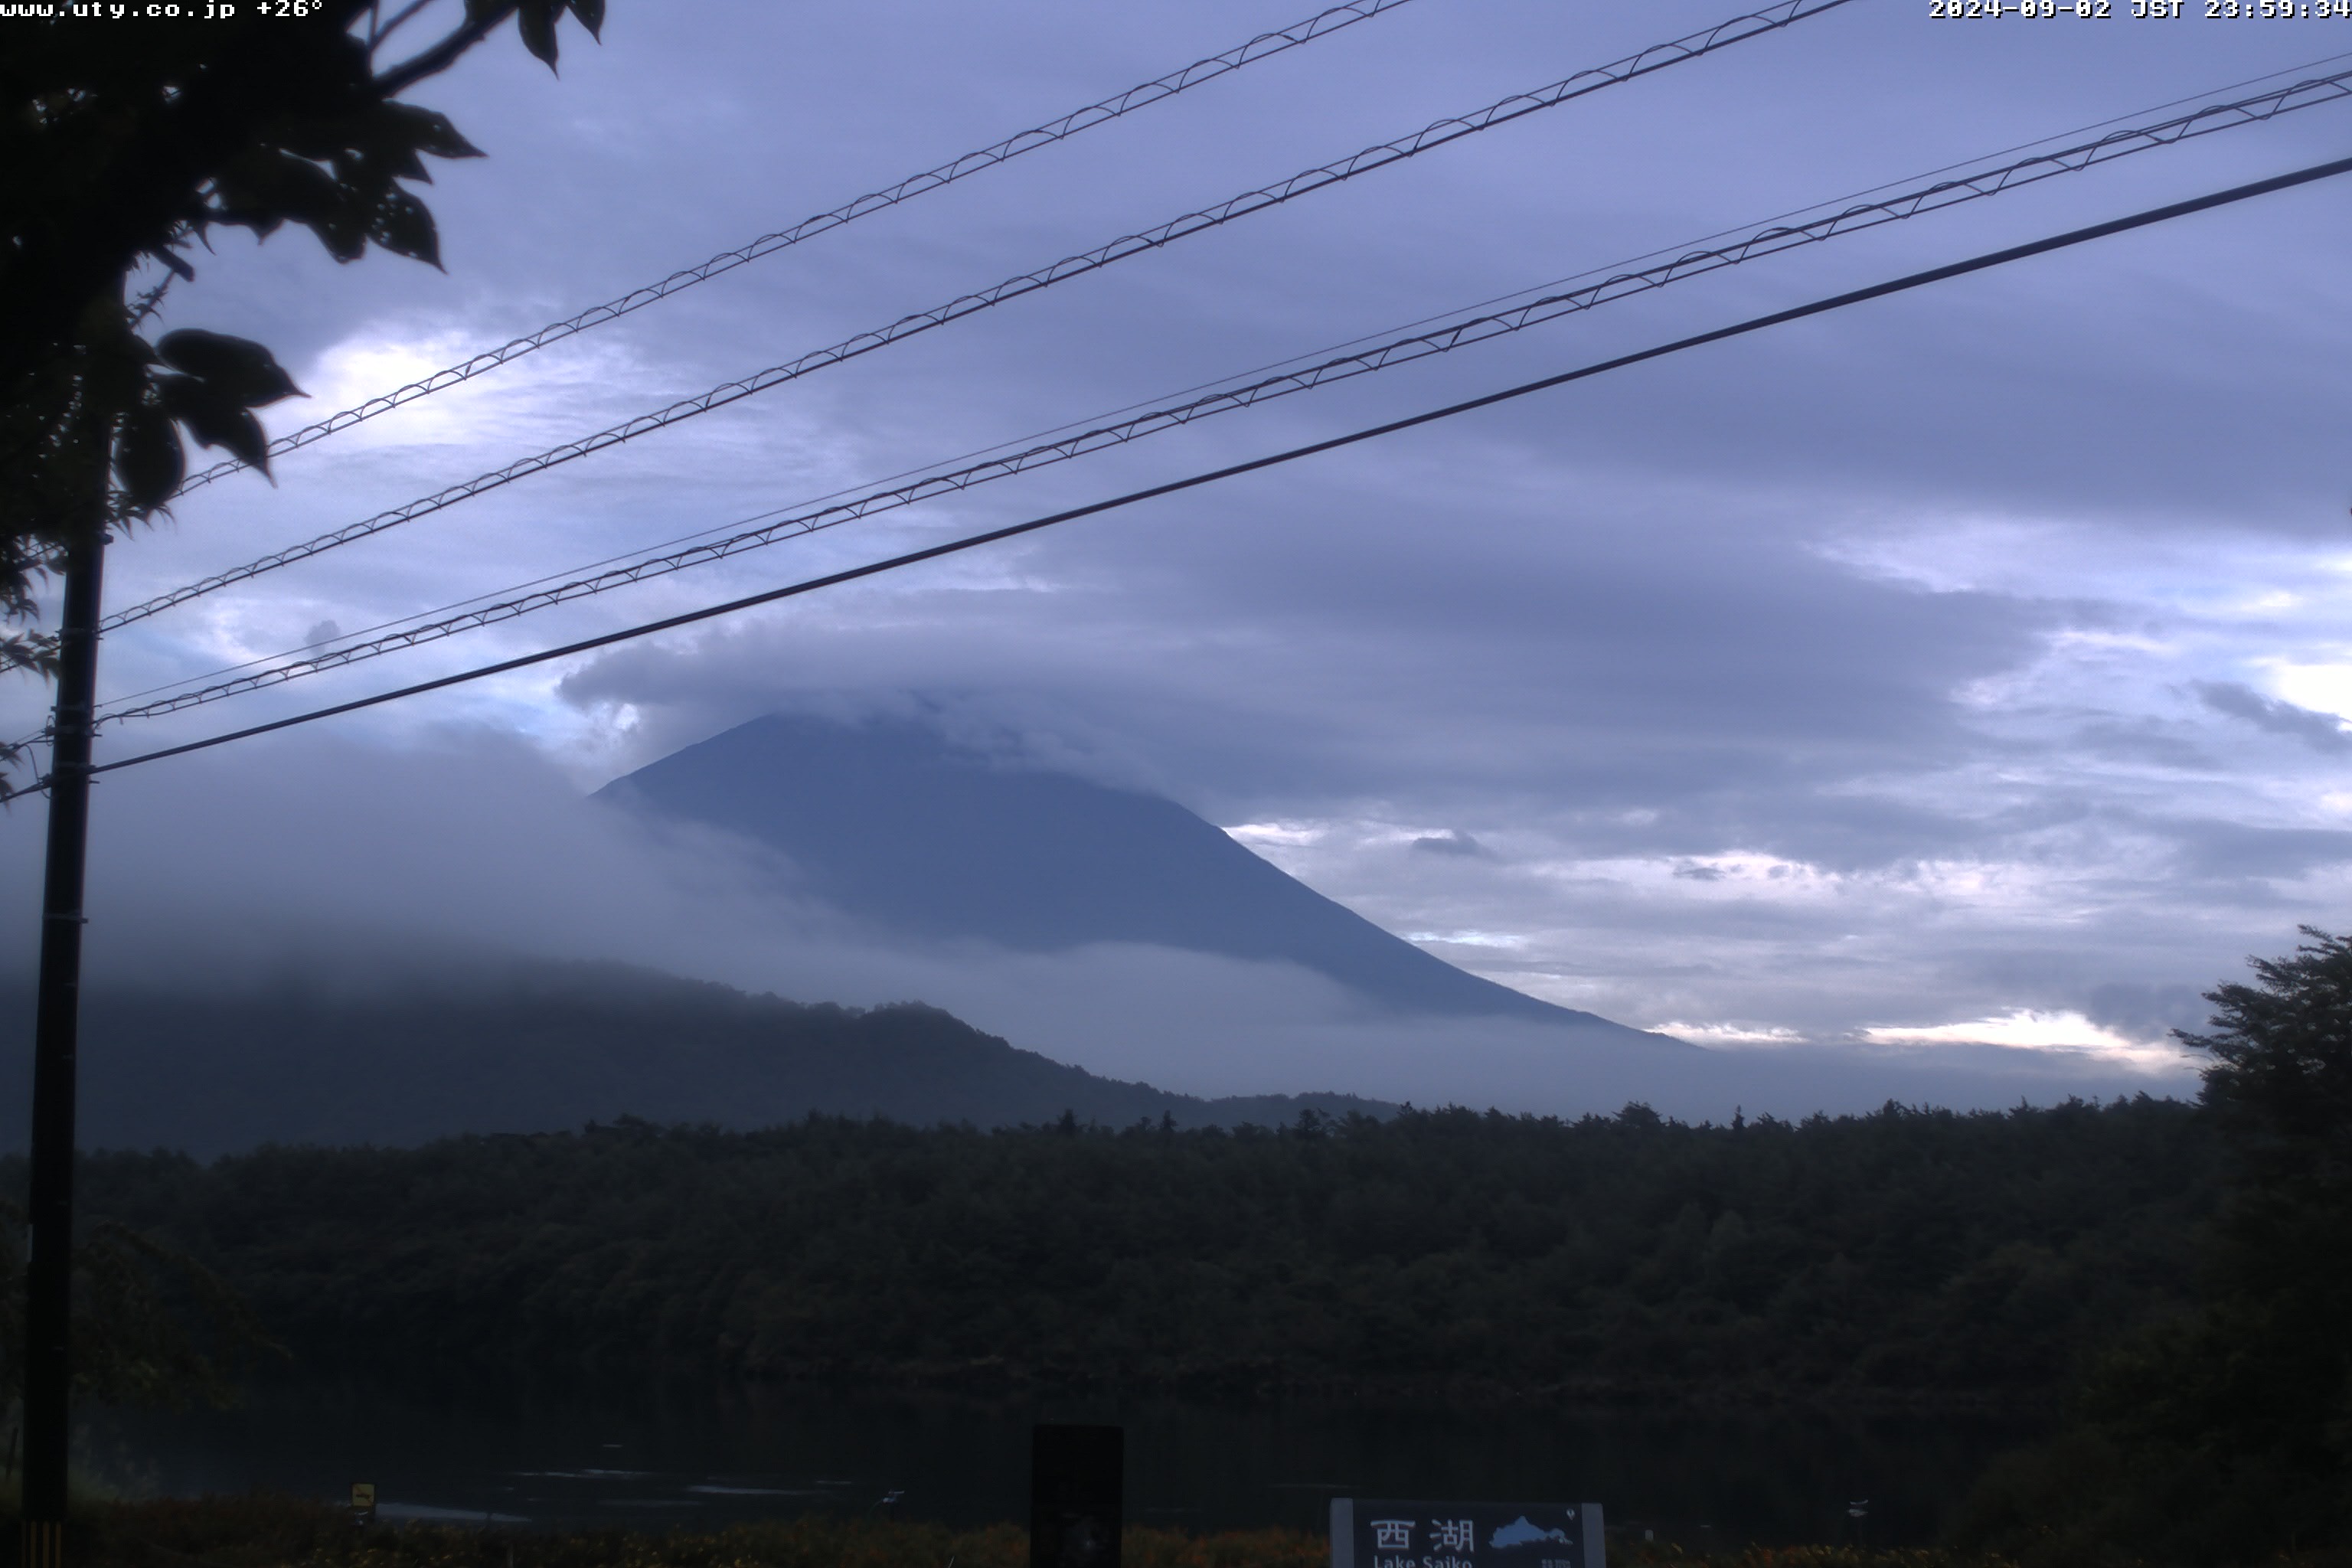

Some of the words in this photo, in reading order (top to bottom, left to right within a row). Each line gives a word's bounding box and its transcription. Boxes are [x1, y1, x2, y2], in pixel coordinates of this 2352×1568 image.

[1370, 1519, 1475, 1553] 西湖
[1374, 1554, 1416, 1568] Lake
[1423, 1554, 1473, 1568] Saiko
